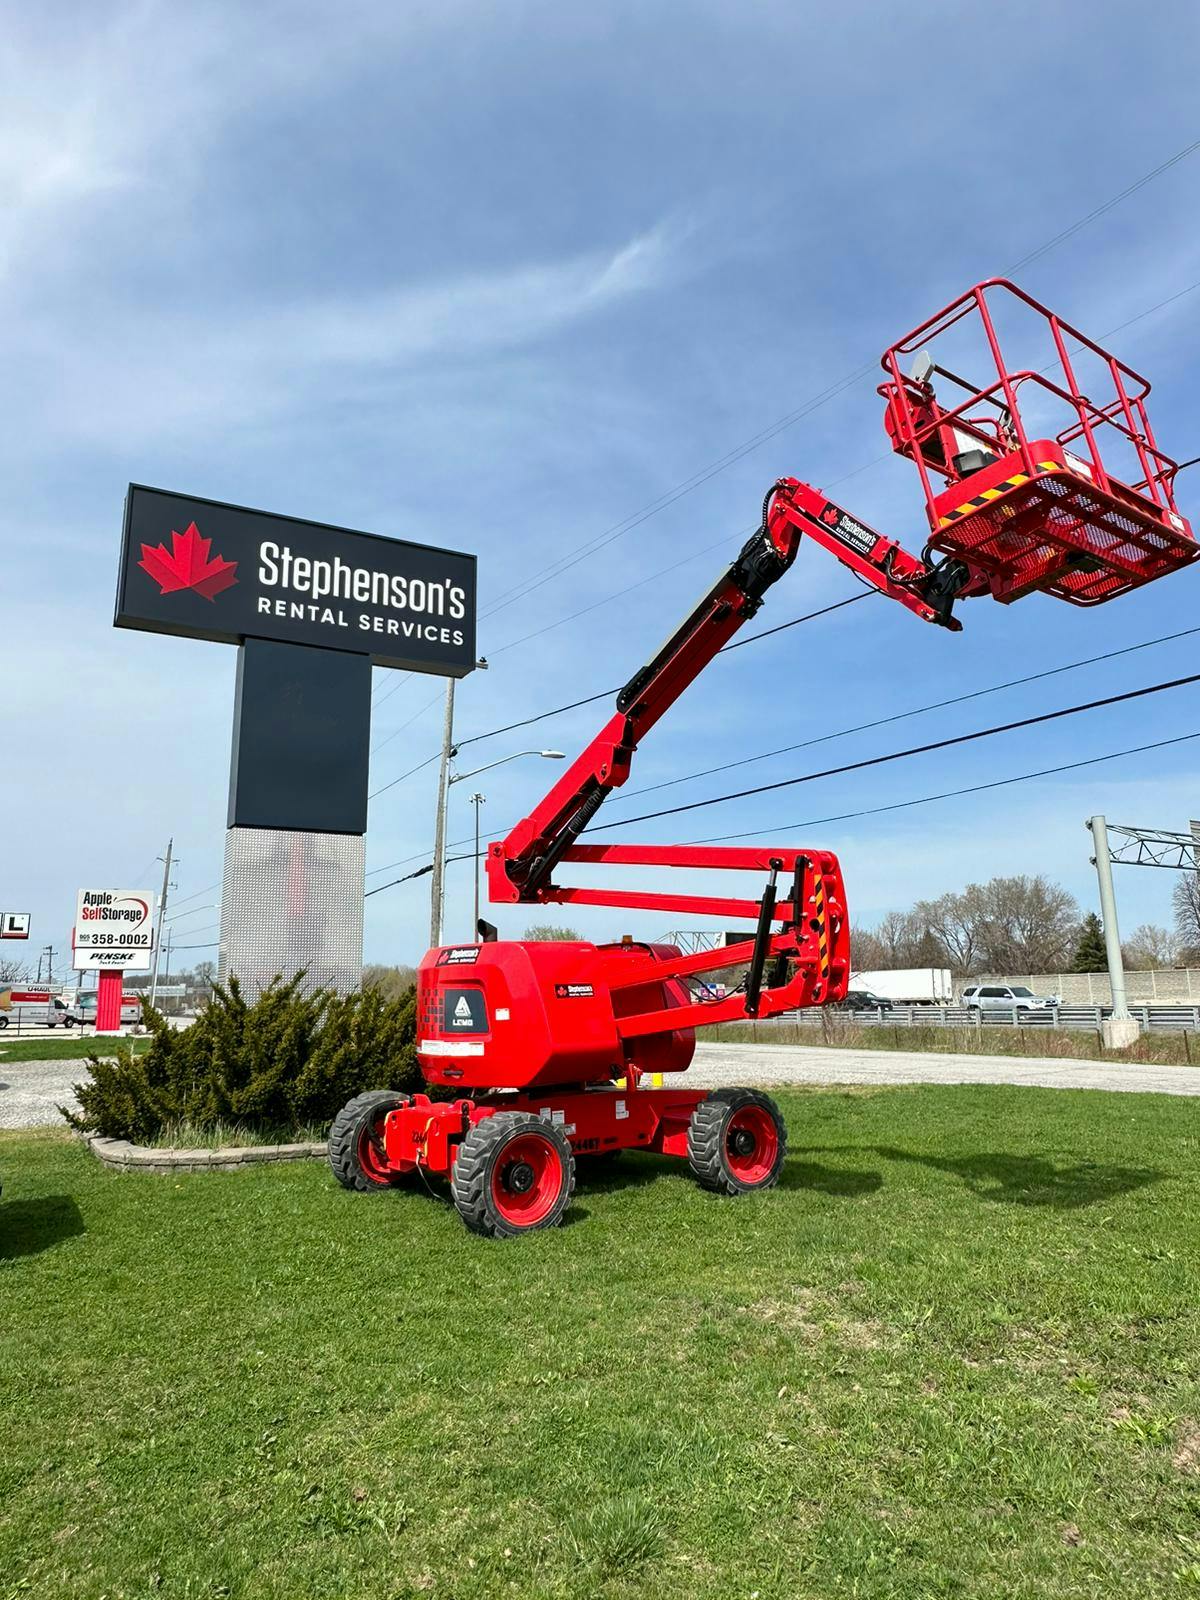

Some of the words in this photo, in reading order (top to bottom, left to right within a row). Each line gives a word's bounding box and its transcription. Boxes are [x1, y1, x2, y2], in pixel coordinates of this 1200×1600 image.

[258, 541, 466, 619] Stephenson's
[258, 597, 349, 627] RENTAL
[359, 614, 464, 646] SERVICES
[83, 892, 112, 906] Apple
[9, 917, 23, 931] L
[92, 933, 148, 945] 358-0002
[89, 952, 136, 960] PENSKE
